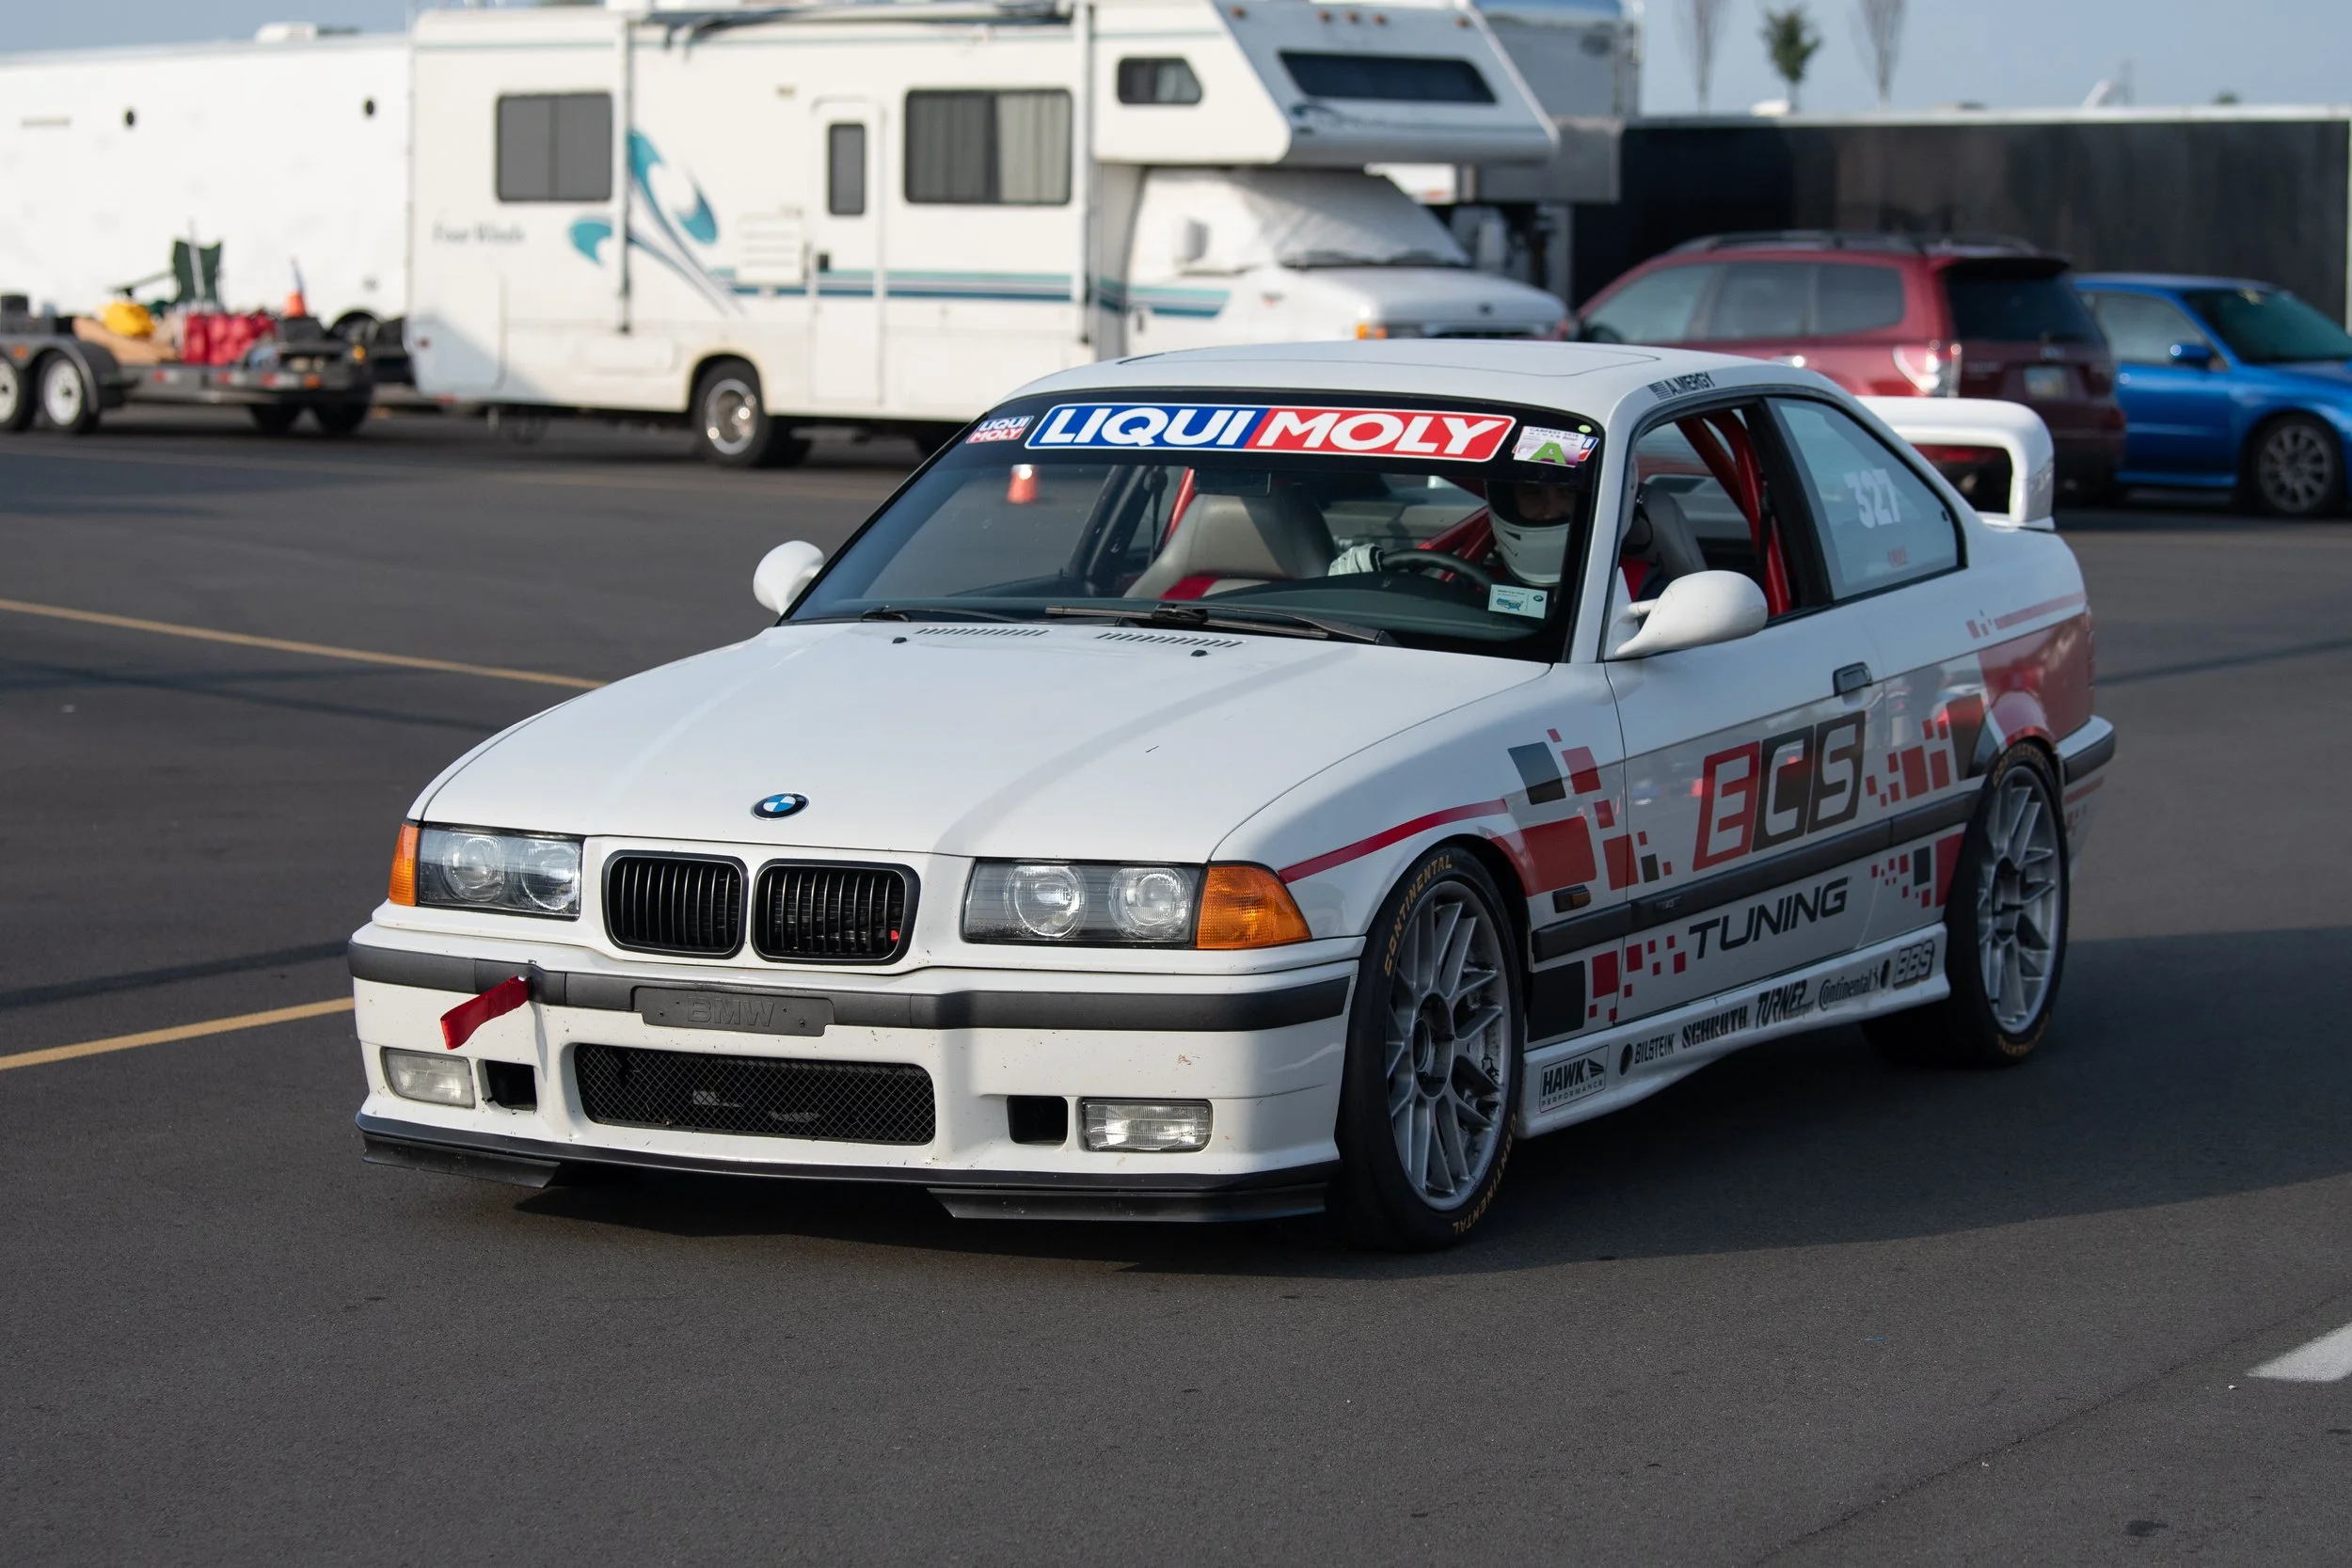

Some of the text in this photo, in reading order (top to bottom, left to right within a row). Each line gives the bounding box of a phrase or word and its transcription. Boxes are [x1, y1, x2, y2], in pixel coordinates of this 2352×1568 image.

[969, 428, 1025, 443] MOLY
[978, 417, 1030, 432] LIQUI
[1040, 407, 1505, 455] LIQUI MOLY
[1844, 468, 1900, 529] 327
[1692, 710, 1866, 872] ECS
[1384, 854, 1453, 977] CONTINENTAL
[1688, 876, 1850, 959] TUNING
[1893, 939, 1936, 990] BBS
[688, 995, 775, 1027] BMW
[1756, 979, 1807, 1028] TURNER
[1819, 969, 1872, 1011] Continental
[1634, 1033, 1676, 1065] BILSTEIN
[1542, 1079, 1603, 1107] PERFORMANCE
[1543, 1058, 1587, 1097] HAWK
